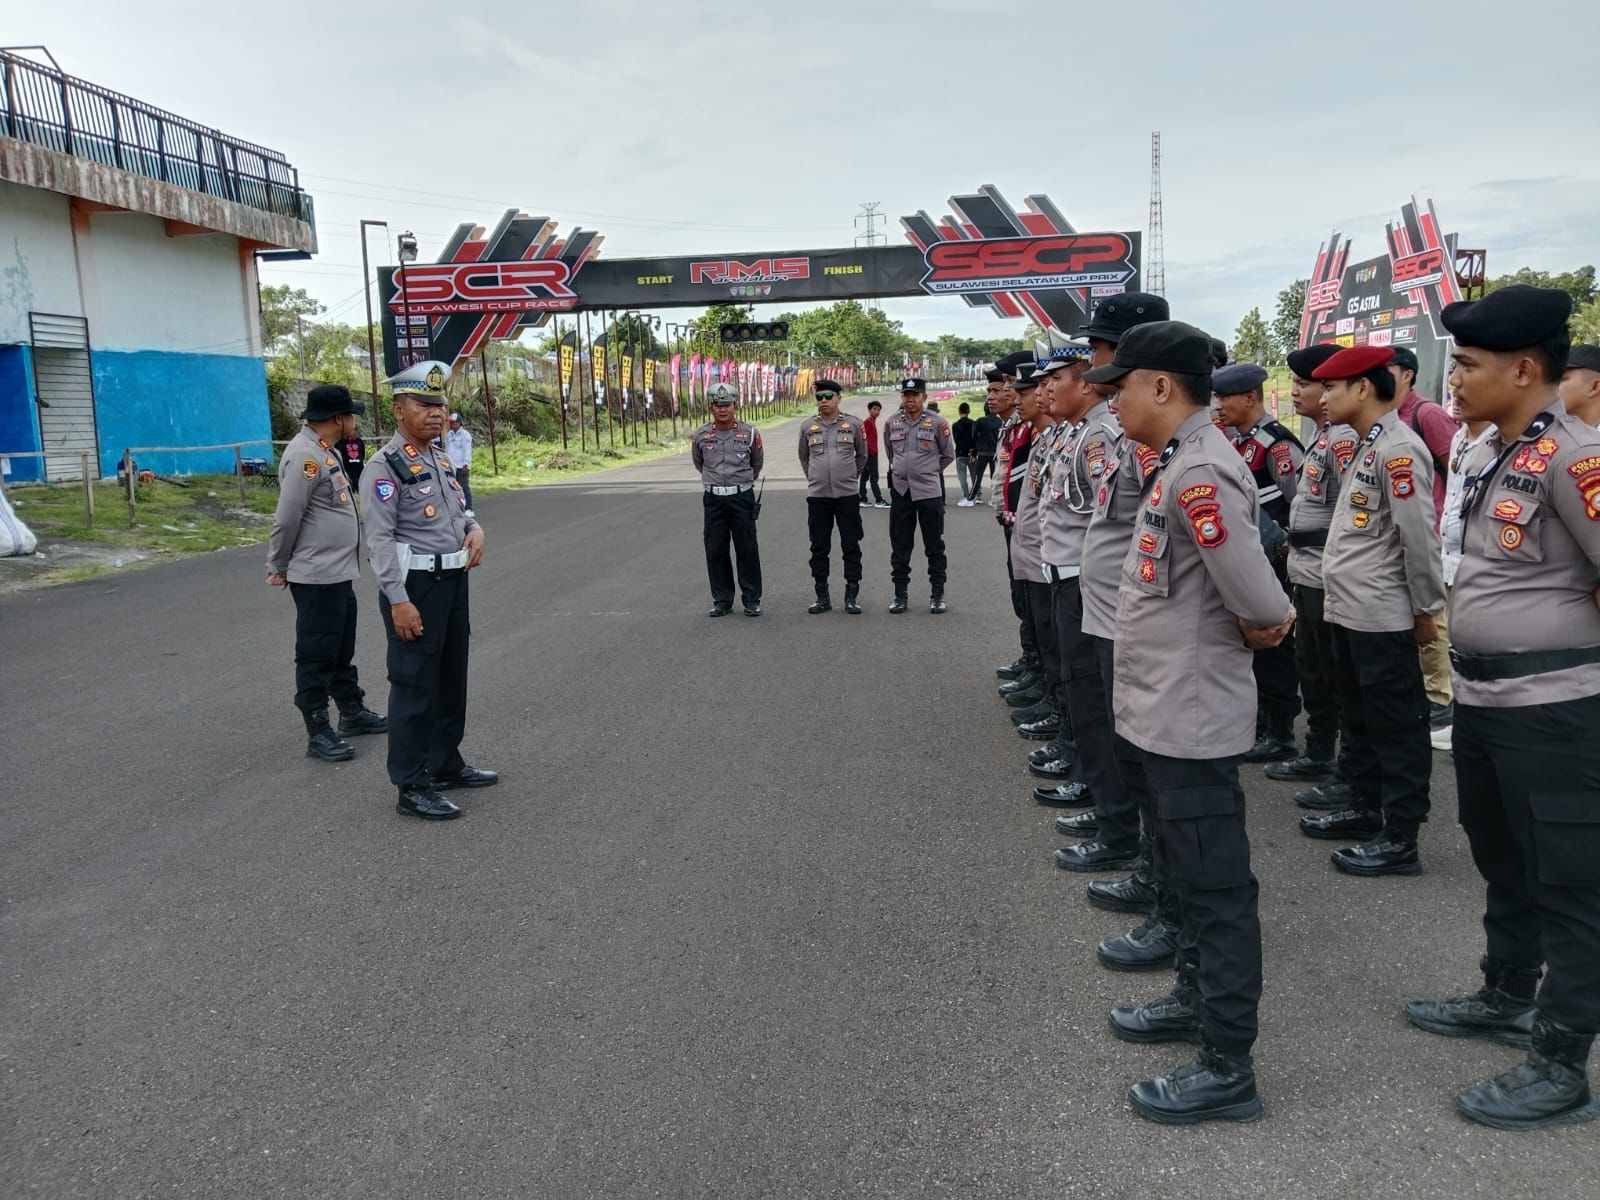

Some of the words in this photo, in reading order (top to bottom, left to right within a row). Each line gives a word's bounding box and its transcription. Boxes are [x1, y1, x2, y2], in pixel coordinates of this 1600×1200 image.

[930, 235, 1126, 280] SSCP
[1393, 249, 1443, 282] SSCP
[637, 275, 674, 285] START
[690, 257, 810, 284] RMS
[823, 265, 863, 275] FINISH
[388, 260, 578, 303] SCR
[935, 280, 1000, 290] SULAWESI
[1001, 277, 1060, 287] SELATAN
[1061, 275, 1087, 283] CUP
[1089, 273, 1119, 281] PRIX
[1309, 279, 1341, 306] SCR
[398, 303, 484, 313] SULAWESI
[525, 300, 570, 308] RACE
[1348, 296, 1360, 314] GS
[1360, 294, 1380, 312] ASTRA
[1181, 486, 1212, 500] POLRES
[1502, 474, 1538, 494] POLRI
[1143, 511, 1166, 529] POLRI
